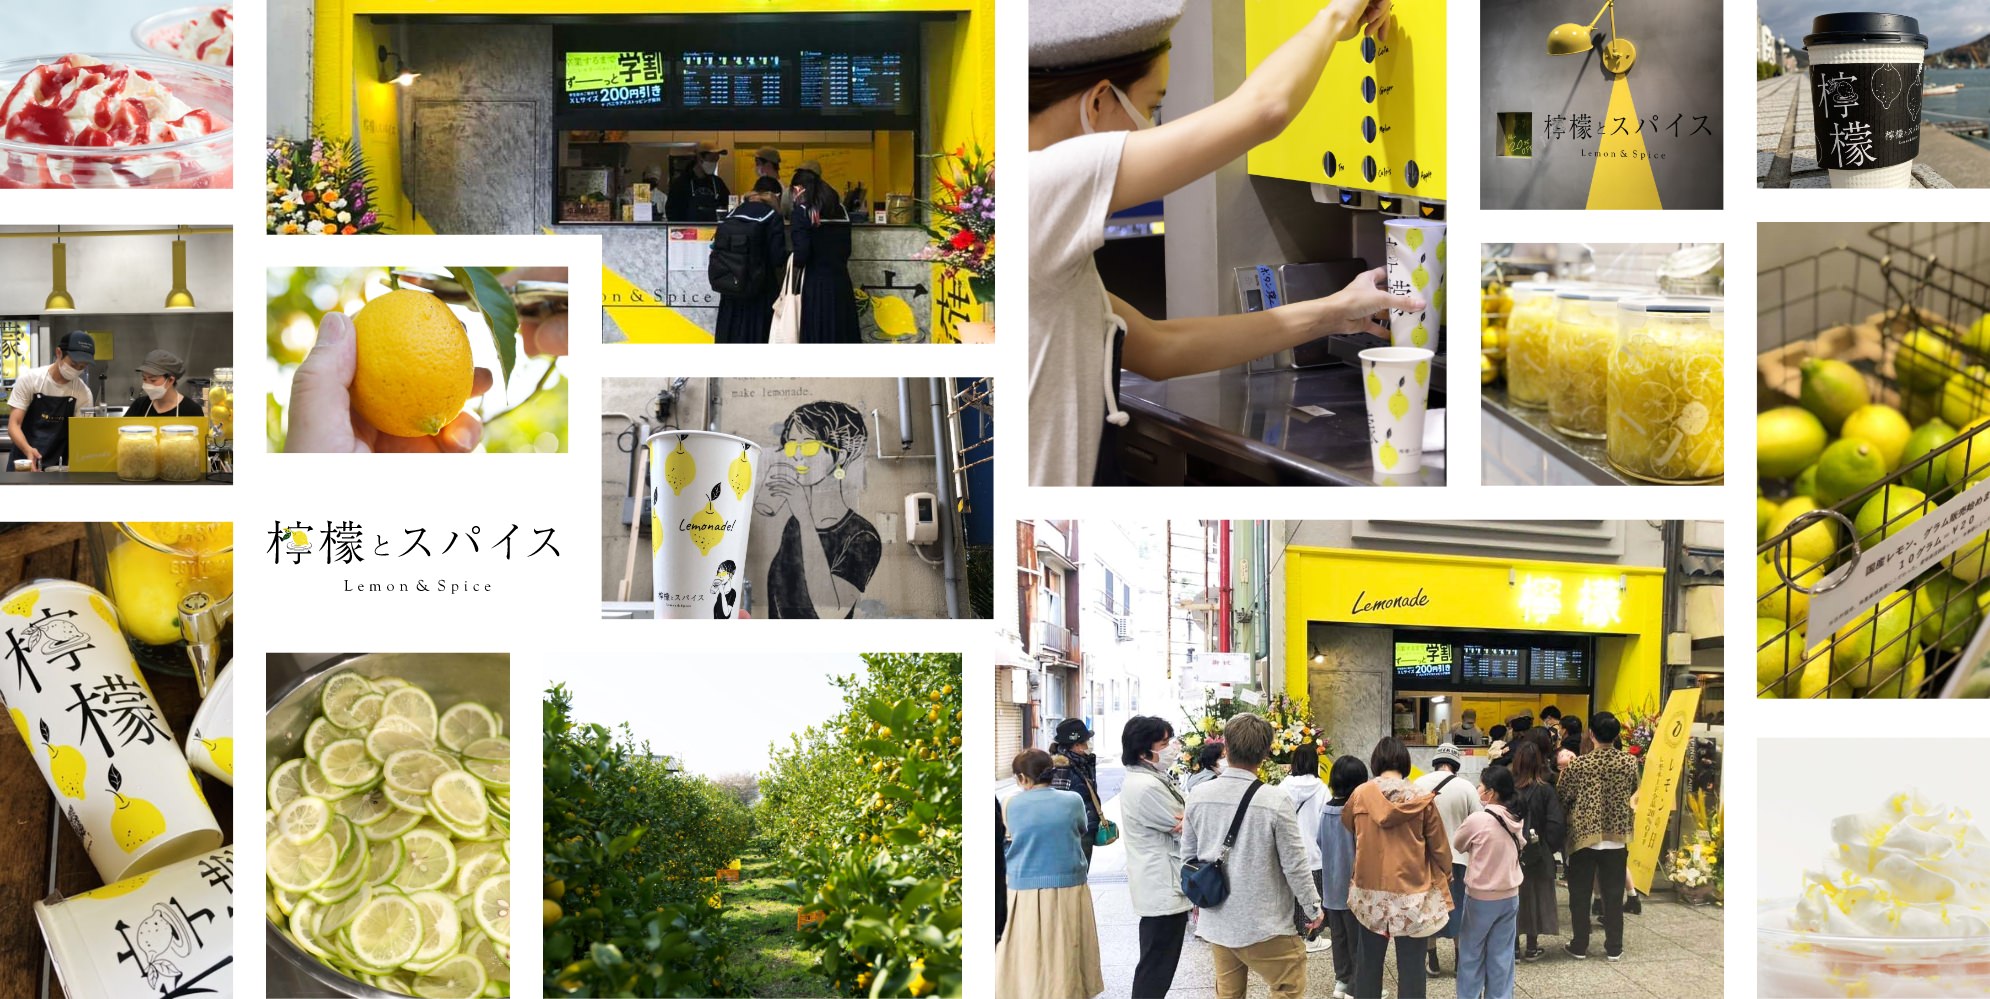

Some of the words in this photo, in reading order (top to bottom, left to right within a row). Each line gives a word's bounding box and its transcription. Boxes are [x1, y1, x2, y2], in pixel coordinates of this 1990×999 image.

[599, 85, 662, 103] 200円引き
[1543, 112, 1713, 141] 檸檬とスパイス
[1581, 148, 1617, 159] Lemon
[1620, 148, 1628, 159] &
[1632, 149, 1667, 161] Spice
[630, 288, 644, 303] &
[653, 287, 712, 306] Spice
[678, 518, 738, 532] Lemonade!
[1351, 587, 1430, 615] Lemonade
